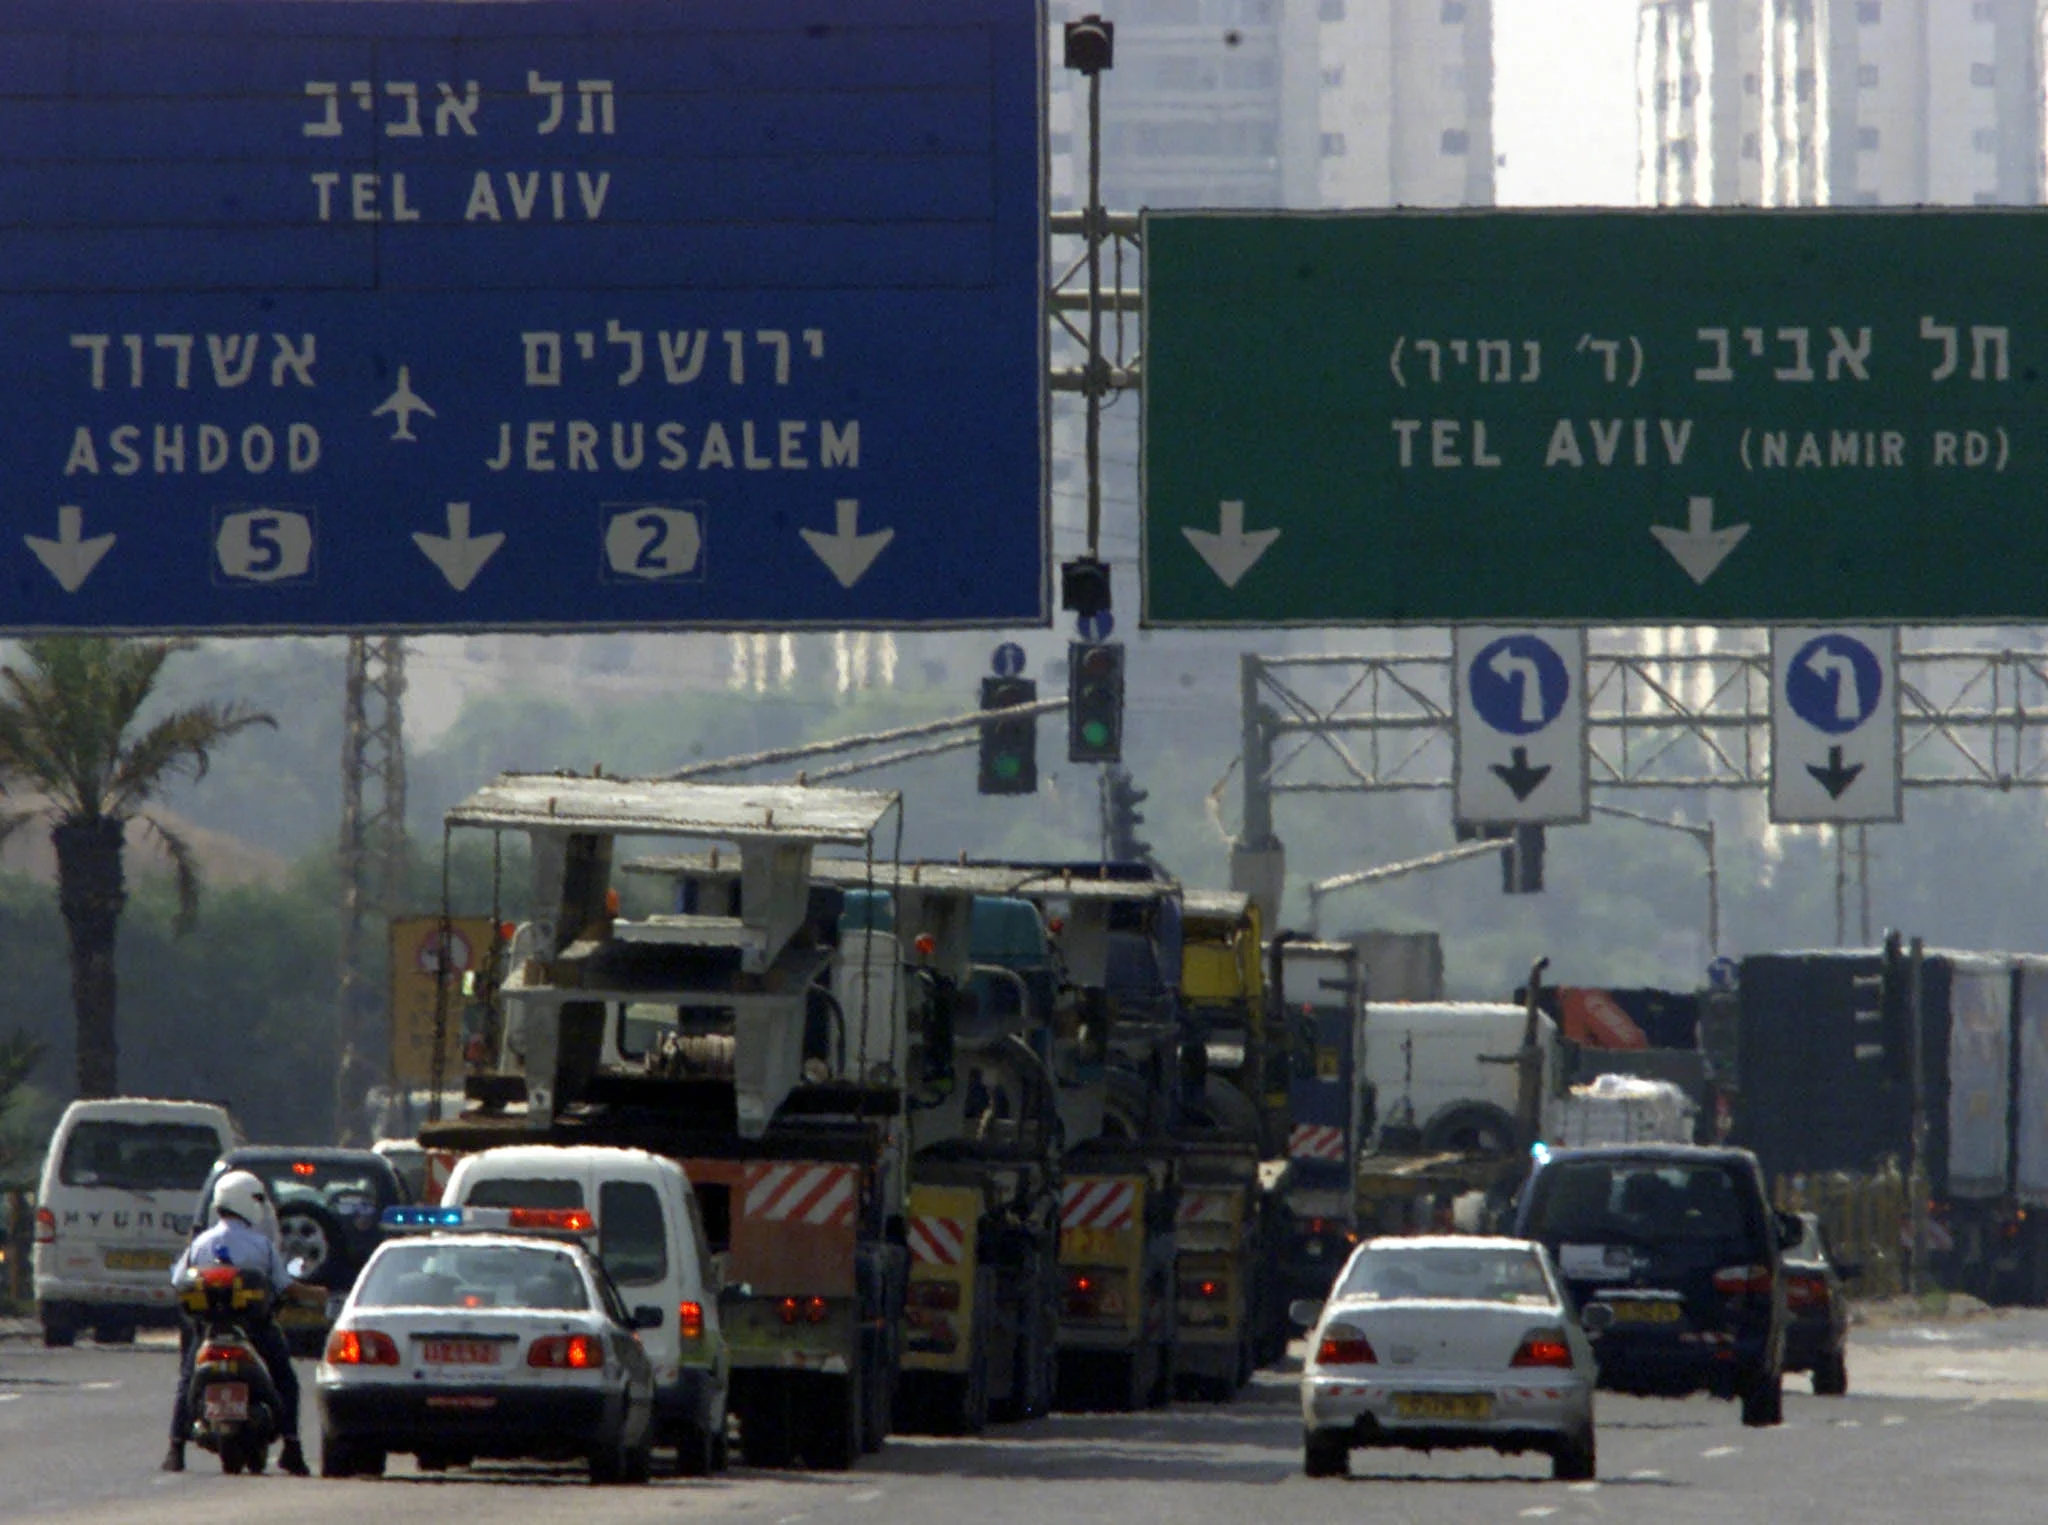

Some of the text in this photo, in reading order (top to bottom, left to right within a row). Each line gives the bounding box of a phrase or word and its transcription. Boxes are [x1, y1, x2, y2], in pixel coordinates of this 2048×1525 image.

[302, 71, 614, 137] תל אביב
[311, 171, 610, 221] TEL AVIV
[69, 331, 317, 389] אשדוד
[522, 321, 825, 385] ירושלים
[1694, 328, 1872, 382] אביב
[1920, 316, 2009, 381] תל
[65, 423, 321, 474] ASHDOD
[487, 419, 861, 471] JERUSALEM
[1392, 418, 2010, 471] TEL AVIV (NAMIR RD)
[245, 517, 282, 572] 5
[633, 513, 669, 570] 2
